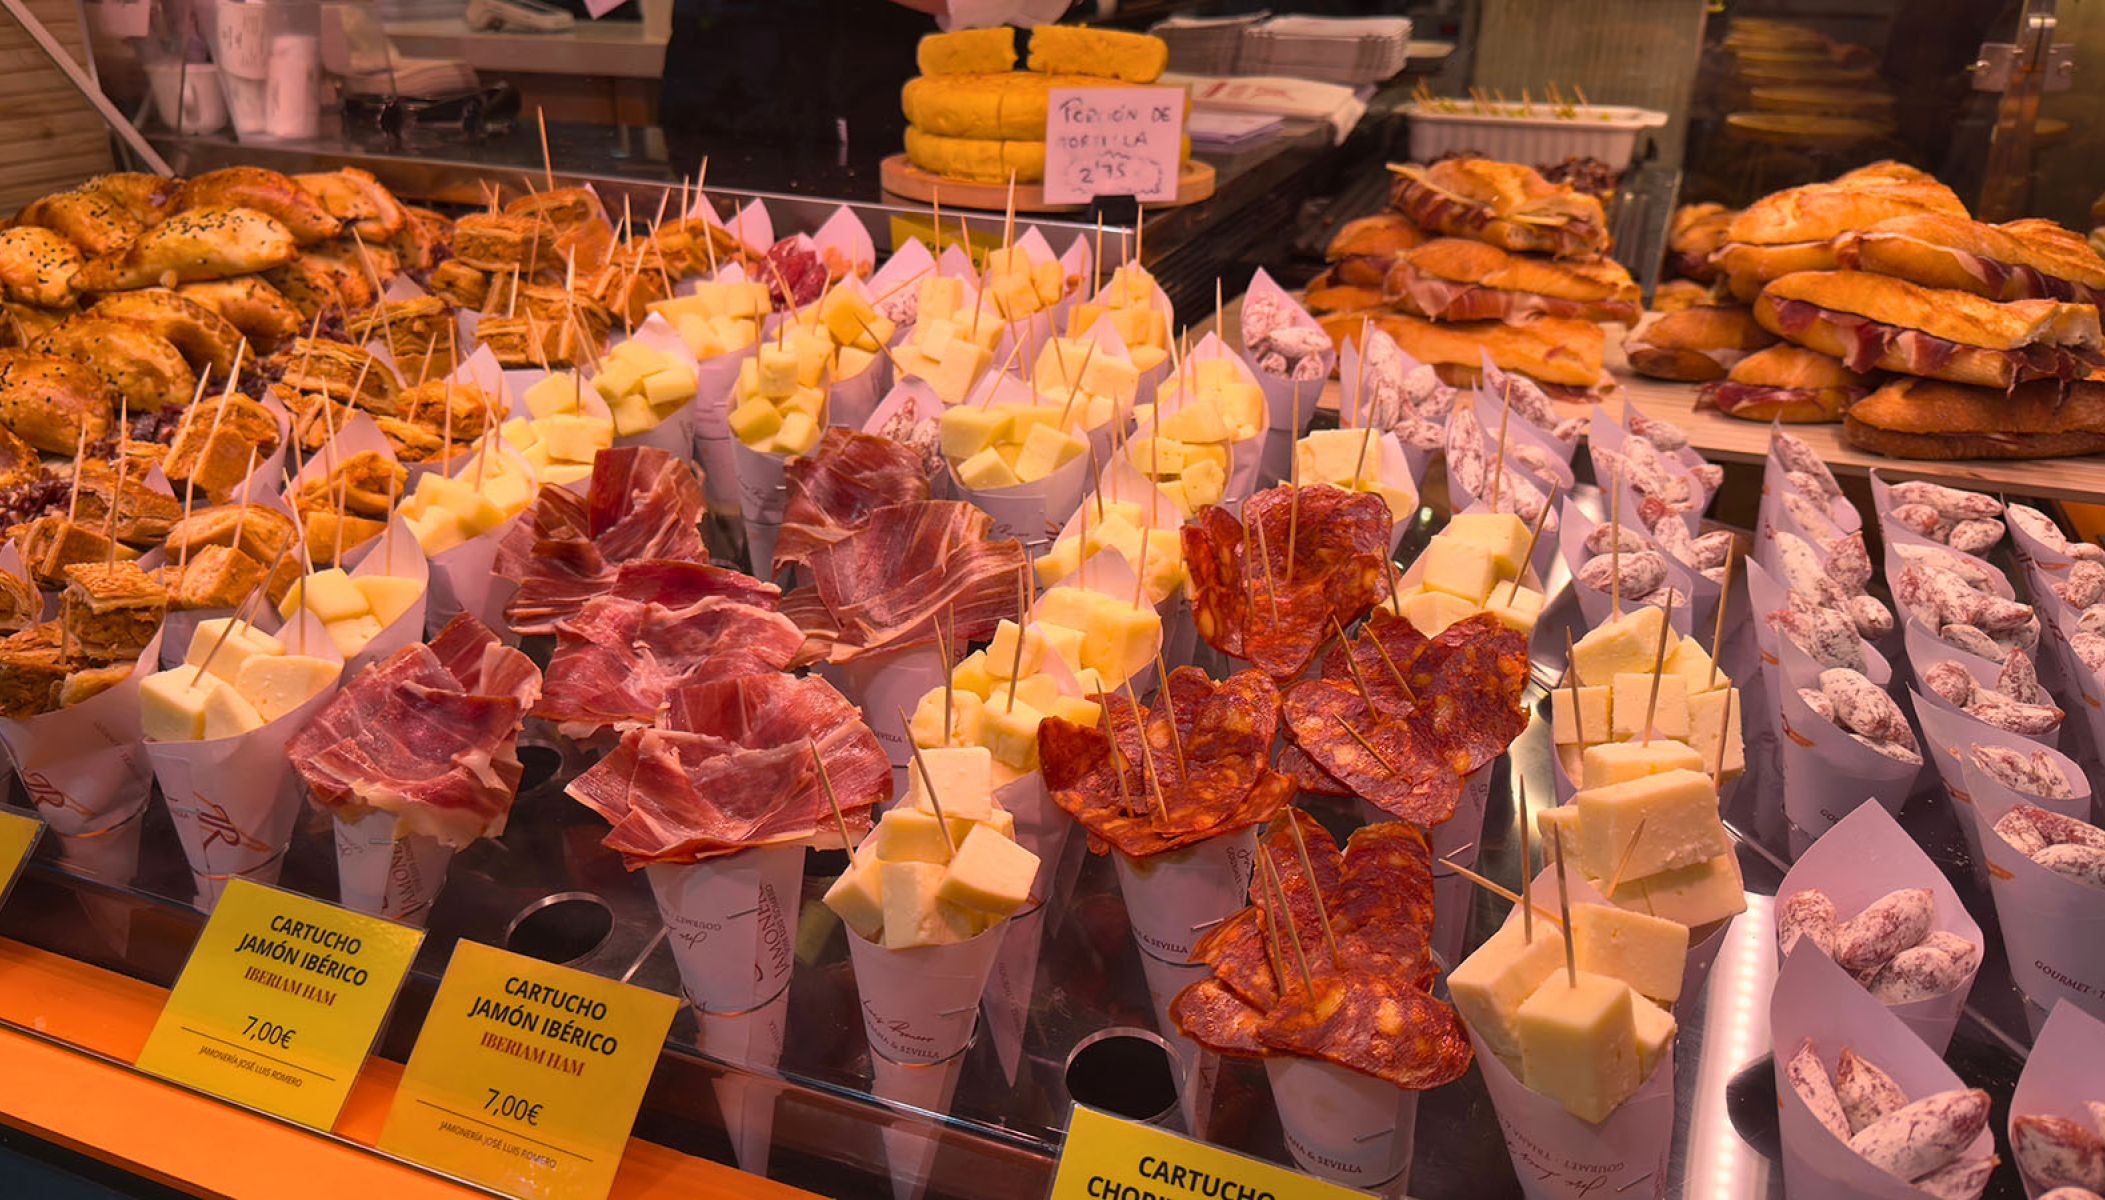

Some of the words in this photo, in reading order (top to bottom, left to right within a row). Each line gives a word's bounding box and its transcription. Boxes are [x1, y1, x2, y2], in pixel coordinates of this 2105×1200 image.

[1151, 107, 1171, 122] DE
[270, 915, 362, 955] CARTUCHO
[1150, 937, 1188, 953] SEVILLA
[234, 934, 300, 965] JAMÓN
[300, 952, 368, 986] IBÉRICO
[2034, 960, 2091, 992] GOURMET
[244, 966, 302, 995] IBERIAM
[302, 985, 337, 1007] HAM
[505, 977, 608, 1021] CARTUCHO
[242, 1016, 296, 1049] 7,00€
[467, 996, 539, 1032] JAMÓN
[540, 1018, 618, 1056] IBÉRICO
[198, 1046, 238, 1065] JAMONERÍA
[236, 1058, 255, 1072] JOSÉ
[254, 1066, 271, 1078] LUIS
[271, 1070, 303, 1087] ROMERO
[480, 1031, 546, 1066] IBERIAM
[546, 1053, 586, 1077] HAM
[900, 1045, 941, 1058] SEVILLA
[483, 1088, 543, 1126] 7,00€
[438, 1120, 483, 1142] JAMONERÍA
[481, 1134, 502, 1150] JOSÉ
[502, 1143, 520, 1156] LUIS
[520, 1149, 557, 1169] ROMERO
[1318, 1155, 1362, 1173] SEVILLA
[1564, 1160, 1624, 1174] GOURMET
